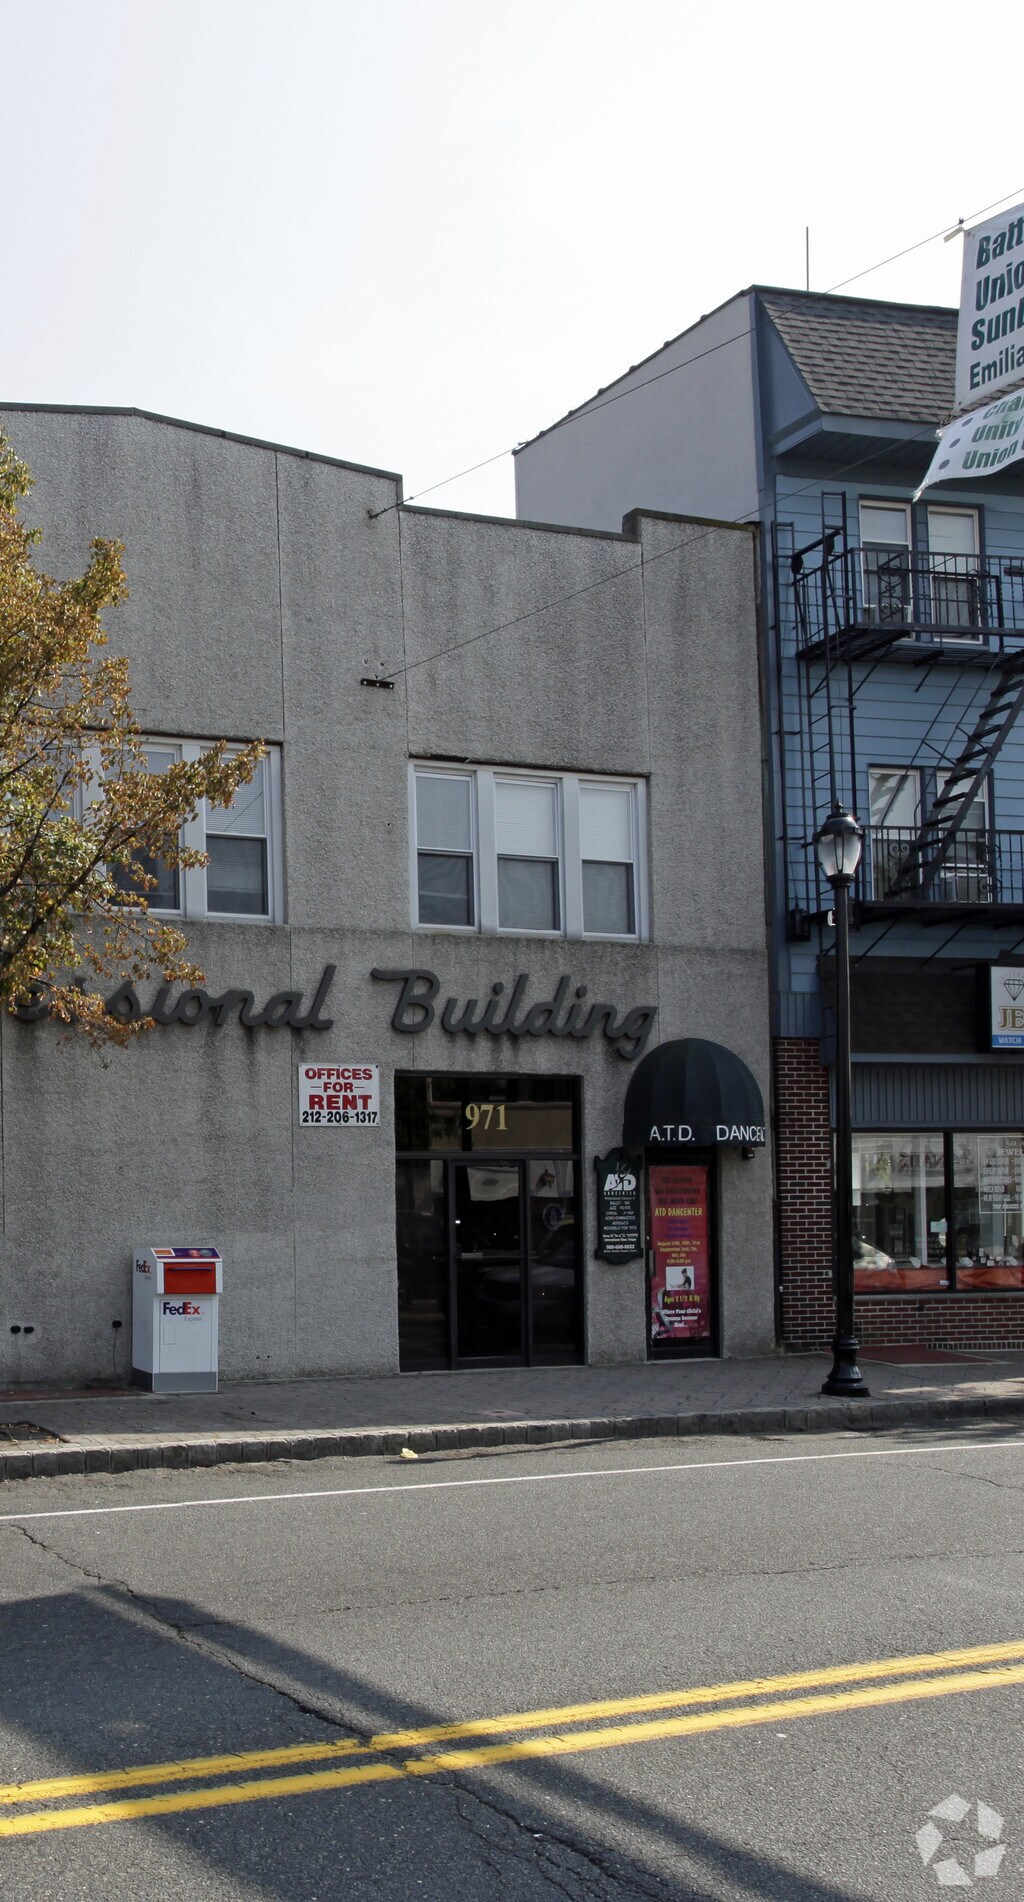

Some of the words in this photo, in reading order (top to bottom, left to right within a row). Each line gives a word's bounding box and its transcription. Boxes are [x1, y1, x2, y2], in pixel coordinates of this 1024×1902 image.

[971, 415, 1024, 443] Unity
[962, 440, 1019, 469] Union
[371, 966, 658, 1059] Building
[998, 1036, 1021, 1044] WATCH
[305, 1068, 373, 1080] OFFICES
[323, 1082, 354, 1093] FOR
[309, 1095, 373, 1110] RENT
[302, 1111, 378, 1123] 212-206-1317
[465, 1104, 508, 1130] 971
[649, 1125, 695, 1141] A.T.D.
[655, 1208, 667, 1216] ATD
[668, 1207, 703, 1217] DANCENTER
[136, 1259, 151, 1274] FedEx
[163, 1302, 201, 1315] FedEx
